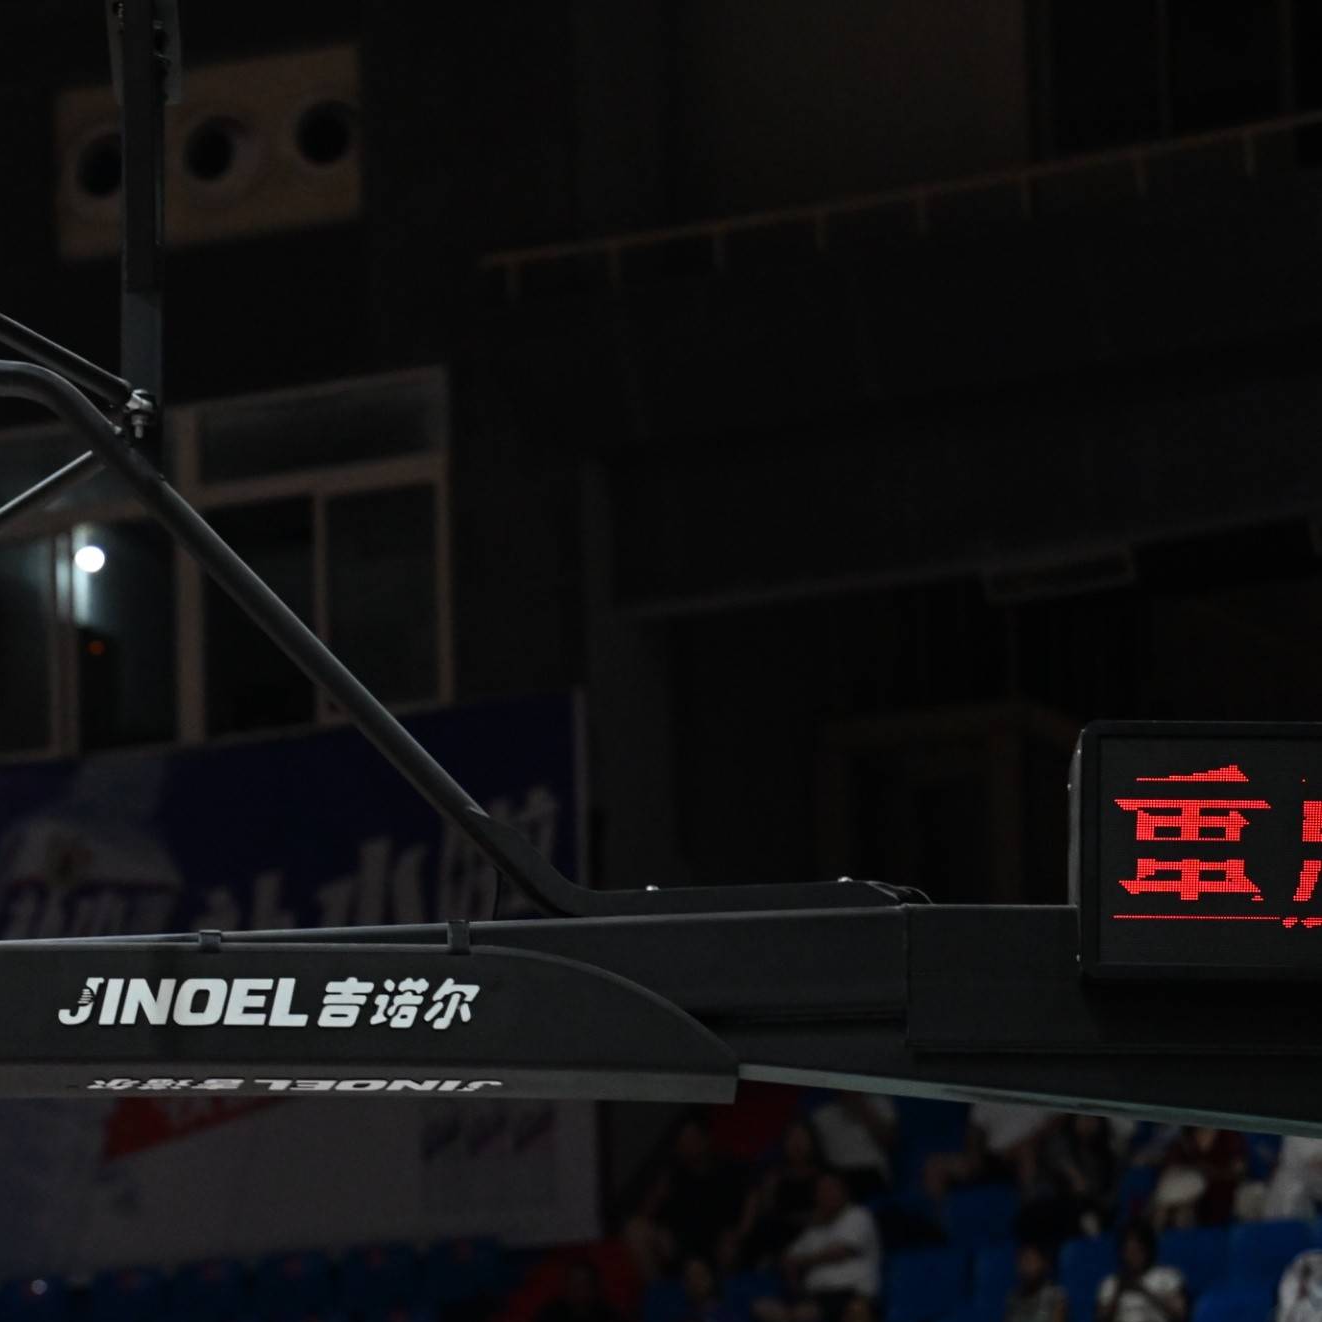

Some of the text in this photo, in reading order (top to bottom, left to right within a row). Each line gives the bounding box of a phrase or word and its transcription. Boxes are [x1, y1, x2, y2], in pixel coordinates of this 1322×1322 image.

[1113, 763, 1322, 928] 重
[57, 975, 482, 1031] JINOEL 吉诺尔
